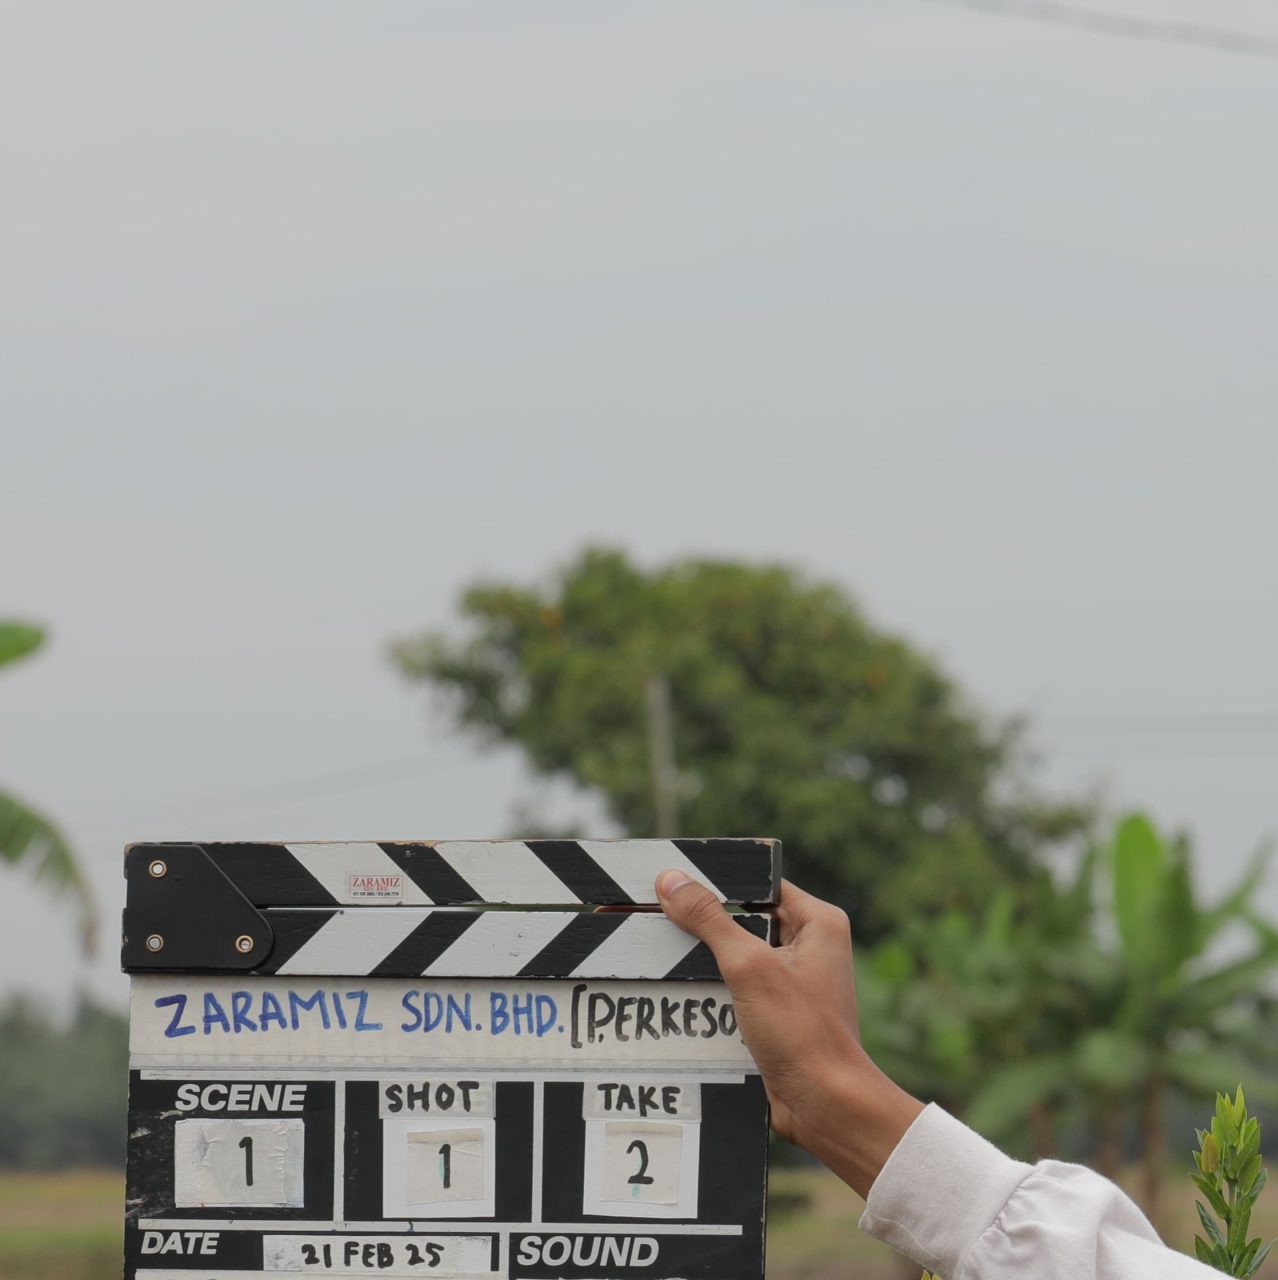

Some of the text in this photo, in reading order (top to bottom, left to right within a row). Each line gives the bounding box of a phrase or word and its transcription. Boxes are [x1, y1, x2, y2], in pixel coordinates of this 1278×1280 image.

[352, 877, 401, 887] ZARAMIZ
[154, 990, 383, 1038] ZARAMIZ
[174, 1083, 307, 1111] SCENE
[385, 1081, 480, 1113] SHOT
[597, 1082, 681, 1117] TAKE
[238, 1136, 253, 1187] 1
[438, 1143, 452, 1189] 1
[626, 1139, 654, 1185] 2
[140, 1232, 220, 1255] DATE
[301, 1241, 445, 1268] 21 FEB 25
[516, 1235, 660, 1267] SOUND
